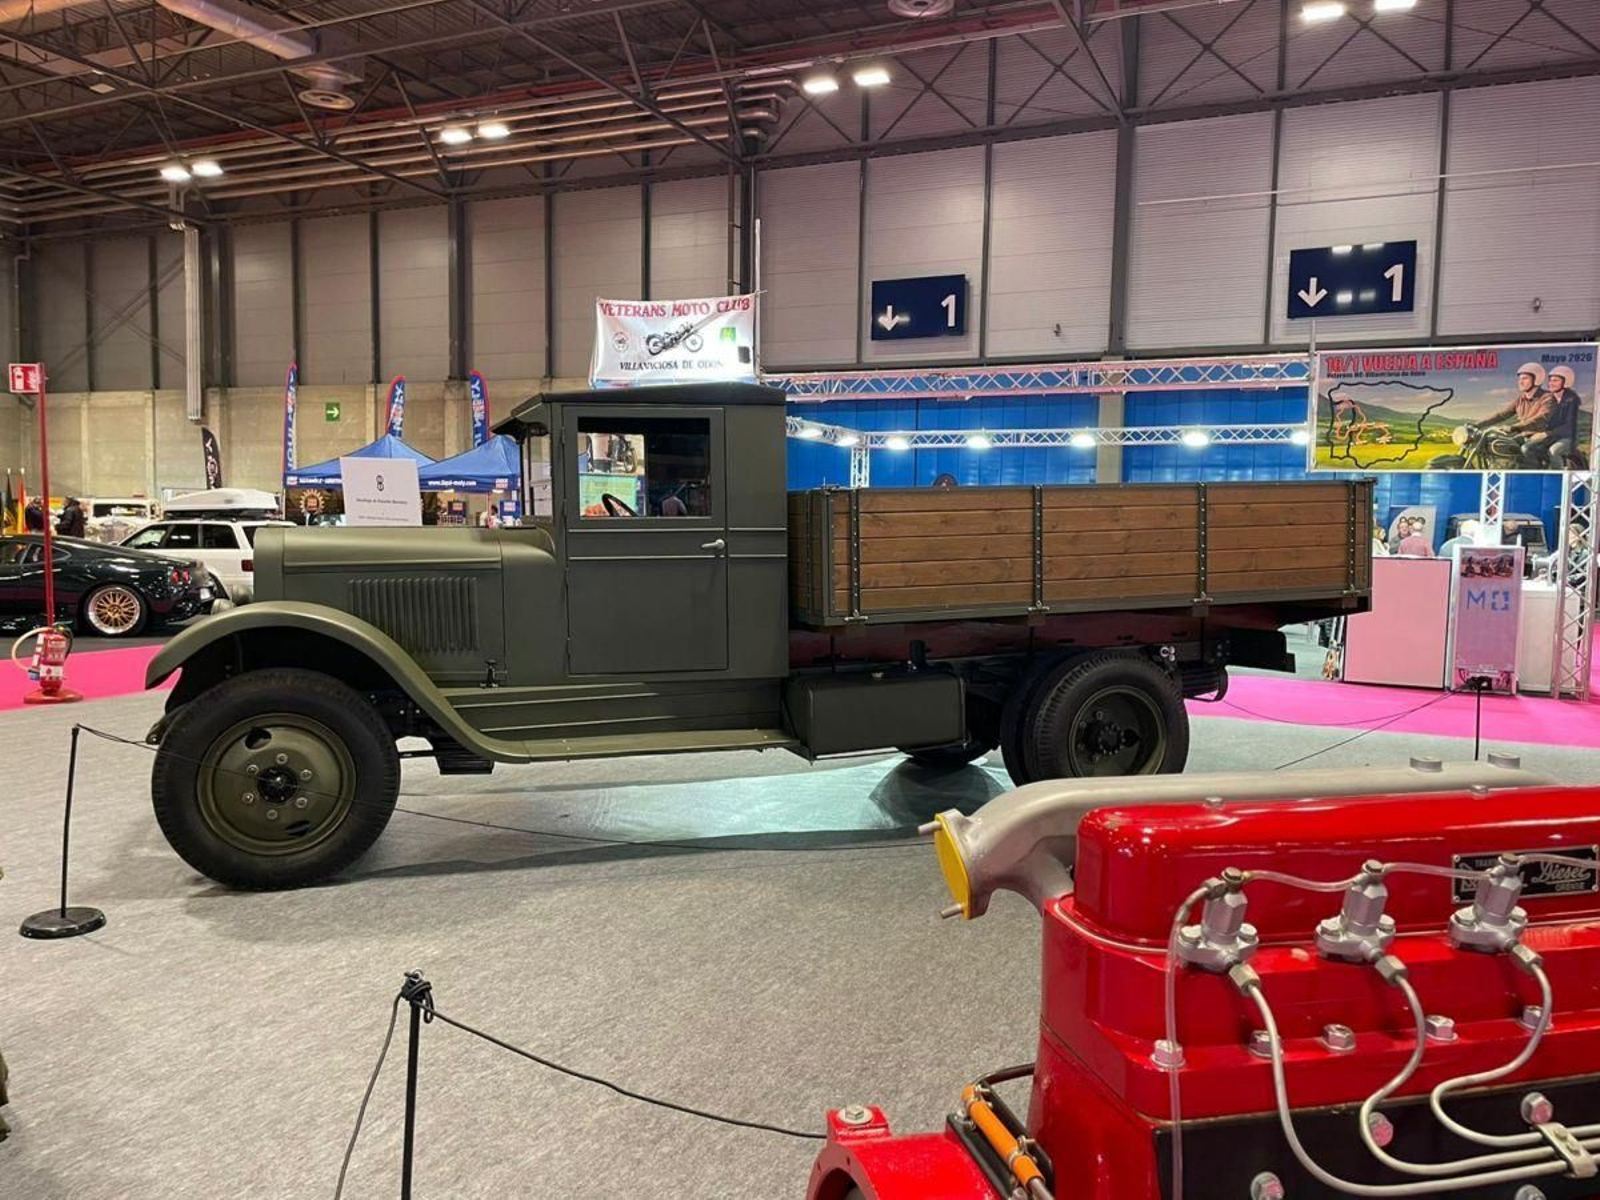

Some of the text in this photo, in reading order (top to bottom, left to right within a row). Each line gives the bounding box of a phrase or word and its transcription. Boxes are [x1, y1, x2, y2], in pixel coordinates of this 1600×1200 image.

[1384, 263, 1404, 302] 1
[599, 297, 750, 318] VETERANS MOTO CLUB
[941, 294, 956, 327] 1
[619, 359, 679, 371] VILLAVICIOSA
[682, 359, 694, 369] DE
[1362, 353, 1418, 372] VUELTA
[1421, 353, 1432, 371] A
[1436, 349, 1499, 370] ESPAÑA
[1541, 353, 1567, 364] Mayo
